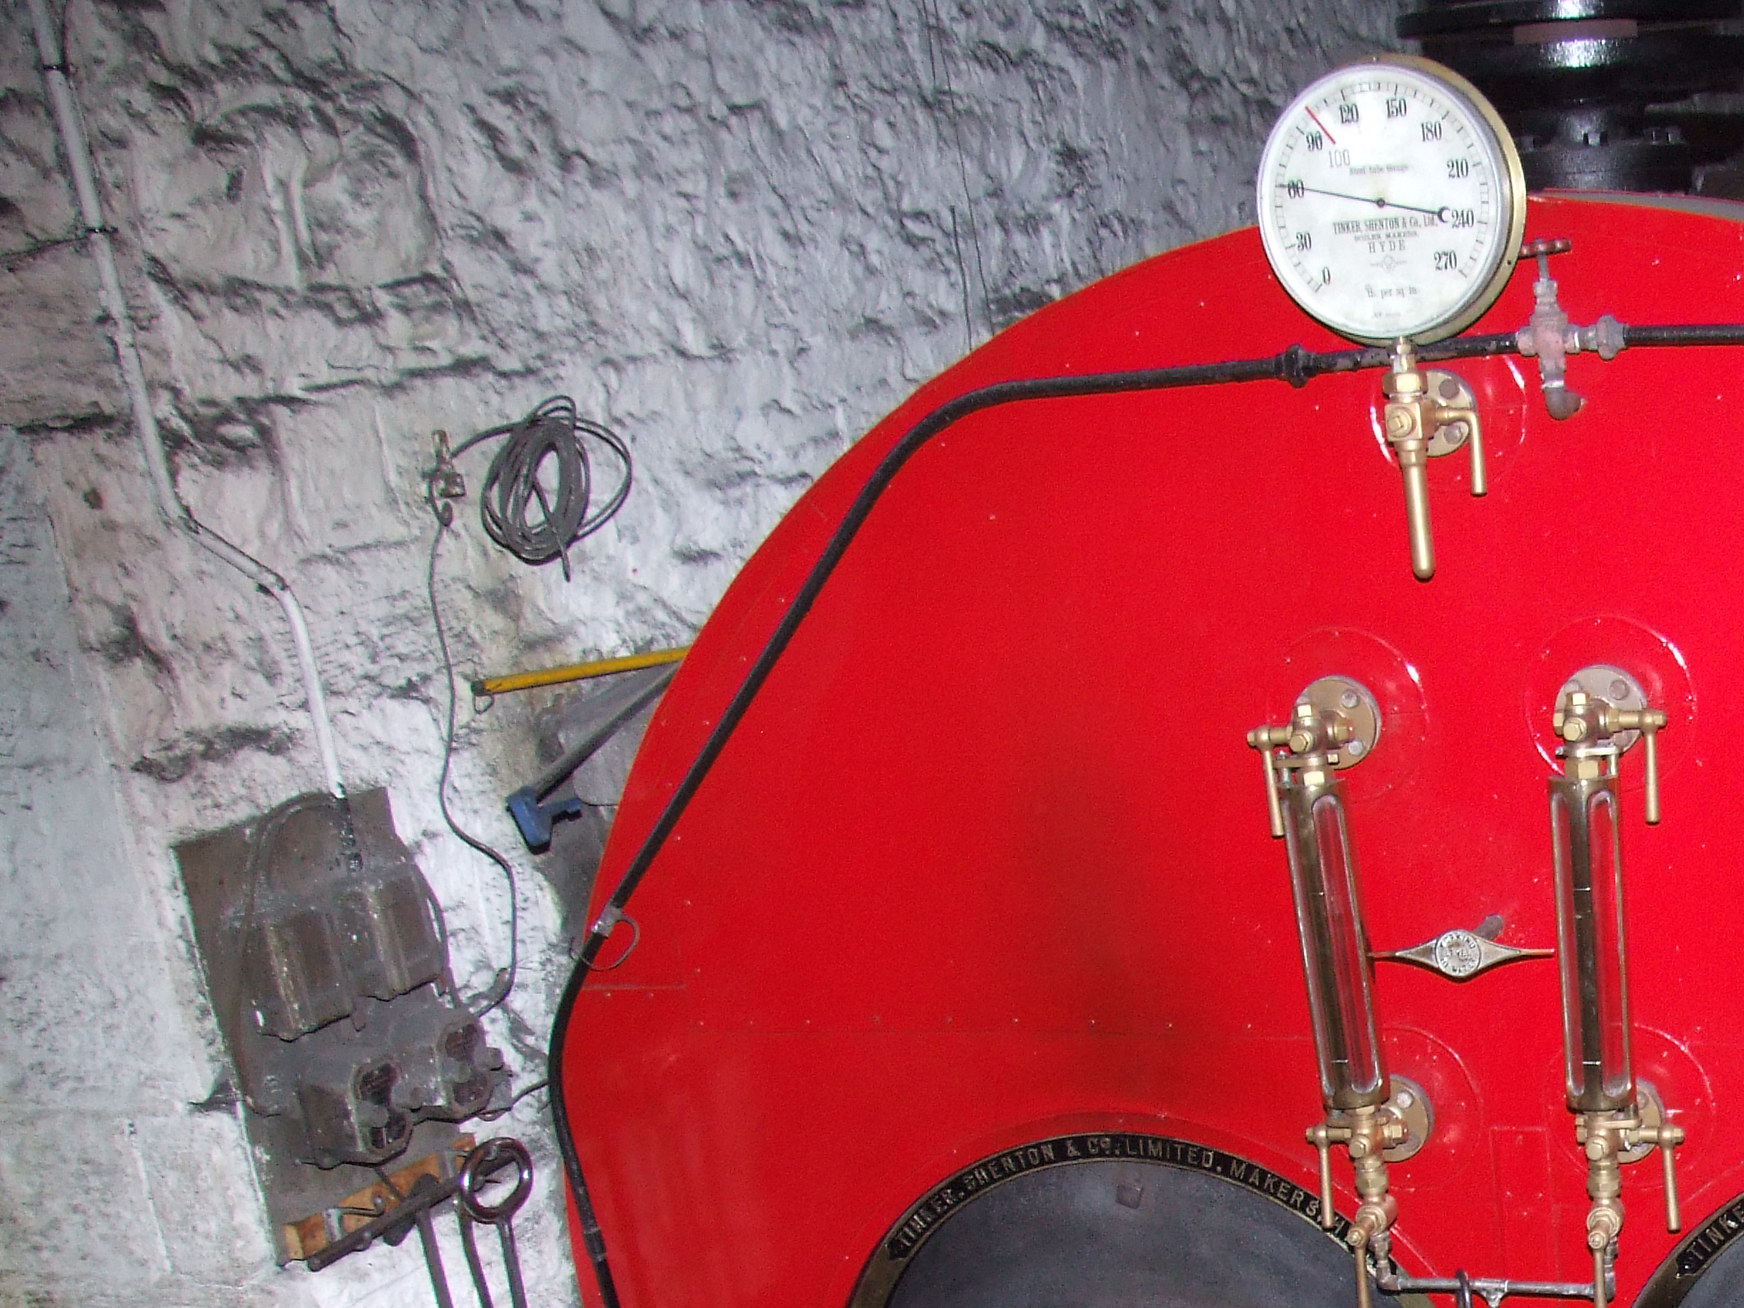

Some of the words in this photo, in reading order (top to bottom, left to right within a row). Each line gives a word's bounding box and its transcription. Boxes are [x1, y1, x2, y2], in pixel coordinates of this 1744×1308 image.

[1339, 103, 1359, 124] 120
[1386, 98, 1407, 118] 150
[1306, 131, 1323, 151] 90
[1421, 121, 1442, 142] 180
[1328, 149, 1351, 168] 100
[1447, 158, 1469, 179] 210
[1287, 179, 1305, 198] 60
[1364, 216, 1400, 232] SHENTON
[1451, 209, 1475, 229] 240
[1295, 232, 1312, 251] 30
[1434, 250, 1458, 271] 270
[1322, 266, 1331, 285] 0
[964, 1144, 1055, 1191] SHENTON
[1066, 1137, 1081, 1157] &
